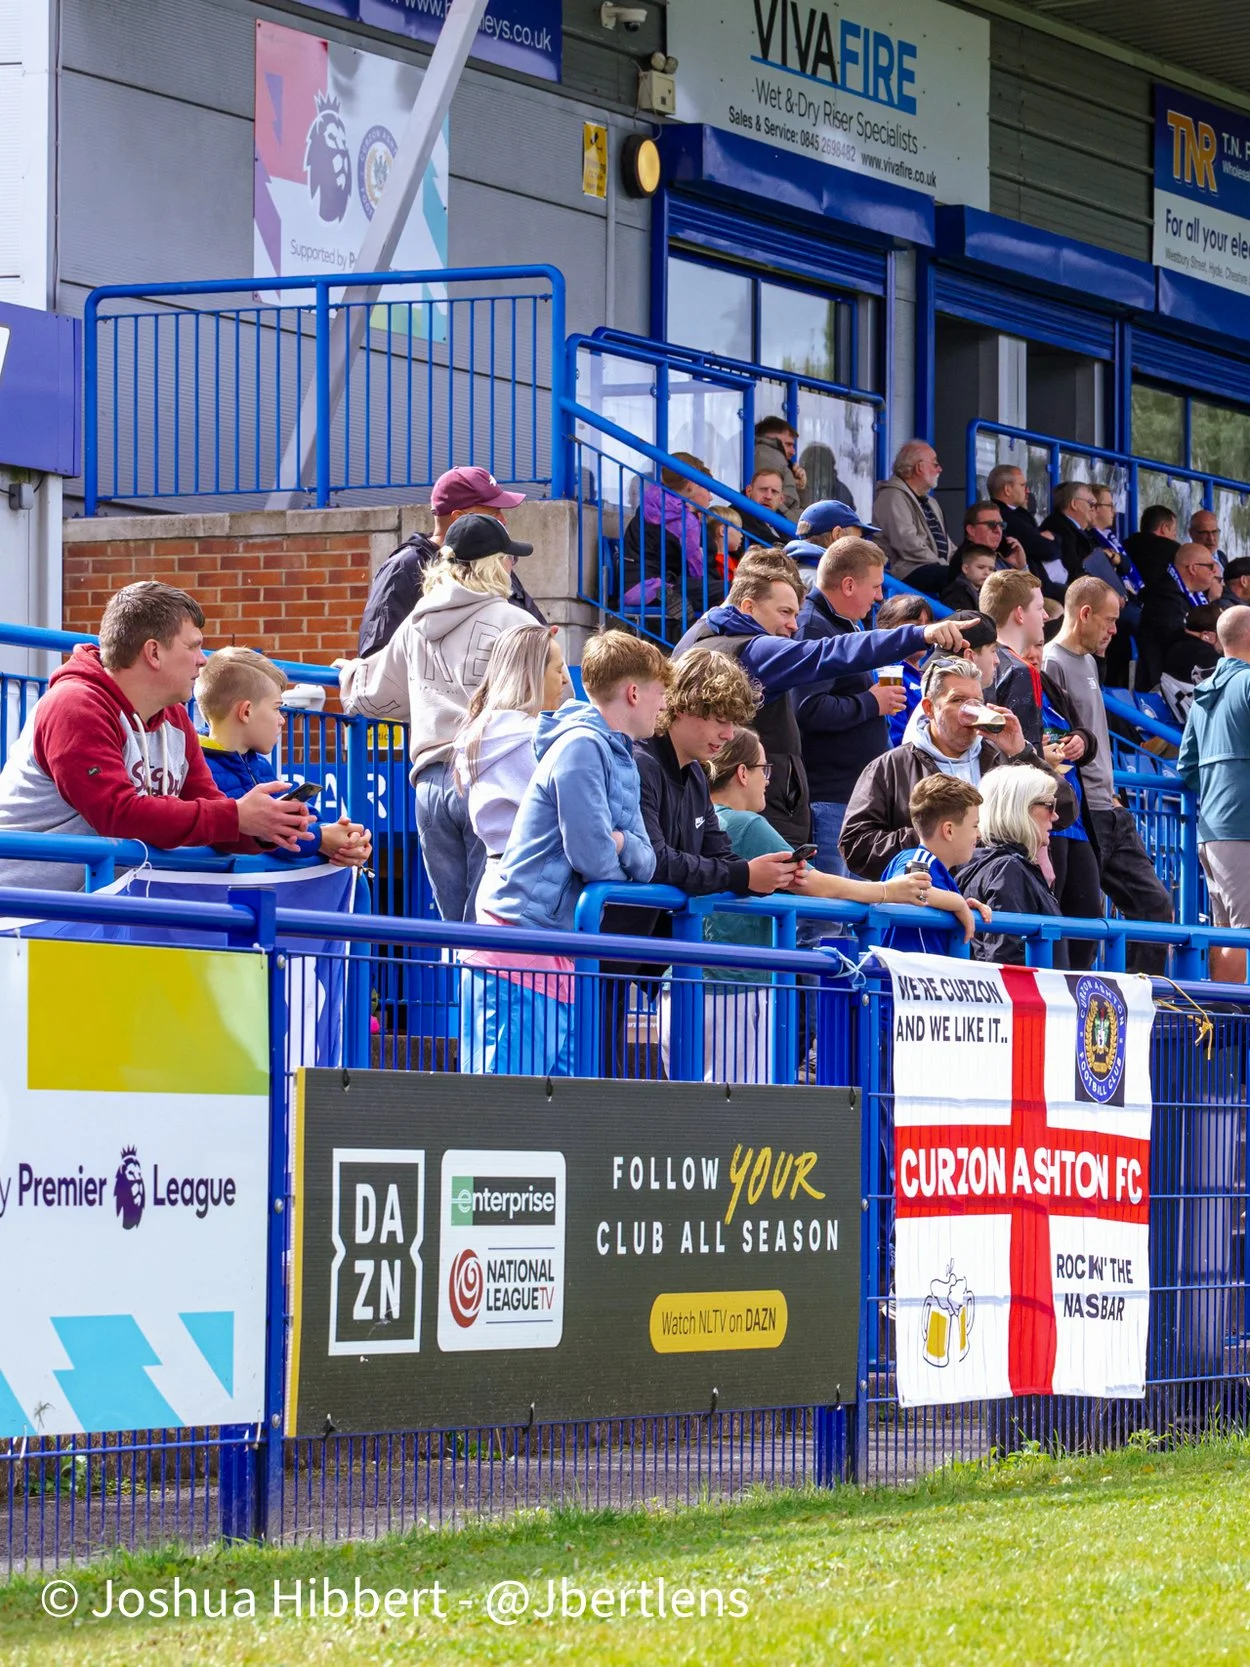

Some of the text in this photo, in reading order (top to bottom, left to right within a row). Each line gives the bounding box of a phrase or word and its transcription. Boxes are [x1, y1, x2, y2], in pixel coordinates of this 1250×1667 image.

[754, 0, 917, 114] VIVAFIRE
[756, 77, 918, 155] Wet & Dry Riser Specialists
[729, 105, 752, 129] Sales
[756, 115, 762, 131] &
[764, 117, 798, 144] Service:
[800, 130, 820, 151] 0845
[861, 151, 937, 188] www.vivafire.co.uk
[1167, 109, 1218, 194] TNR
[1222, 132, 1243, 158] T.N.
[1165, 208, 1183, 238] For
[1186, 217, 1200, 243] all
[1203, 226, 1228, 252] your
[290, 239, 336, 265] Supported
[337, 253, 347, 271] by
[941, 978, 1003, 1004] CURZON
[1095, 981, 1125, 1026] ASHTON
[896, 1015, 925, 1042] AND
[930, 1015, 950, 1042] WE
[955, 1016, 984, 1042] LIKE
[1107, 1057, 1121, 1090] CLUB
[18, 1163, 107, 1207] Premier
[153, 1164, 236, 1219] League
[613, 1143, 826, 1225] FOLLOW YOUR
[901, 1146, 1142, 1206] CURZON ASHTON FC
[457, 1185, 555, 1220] enterprise
[596, 1219, 839, 1256] CLUB ALL SEASON
[487, 1259, 555, 1284] NATIONAL
[1110, 1257, 1133, 1284] THE
[662, 1307, 777, 1336] Watch NLTV on DAZN
